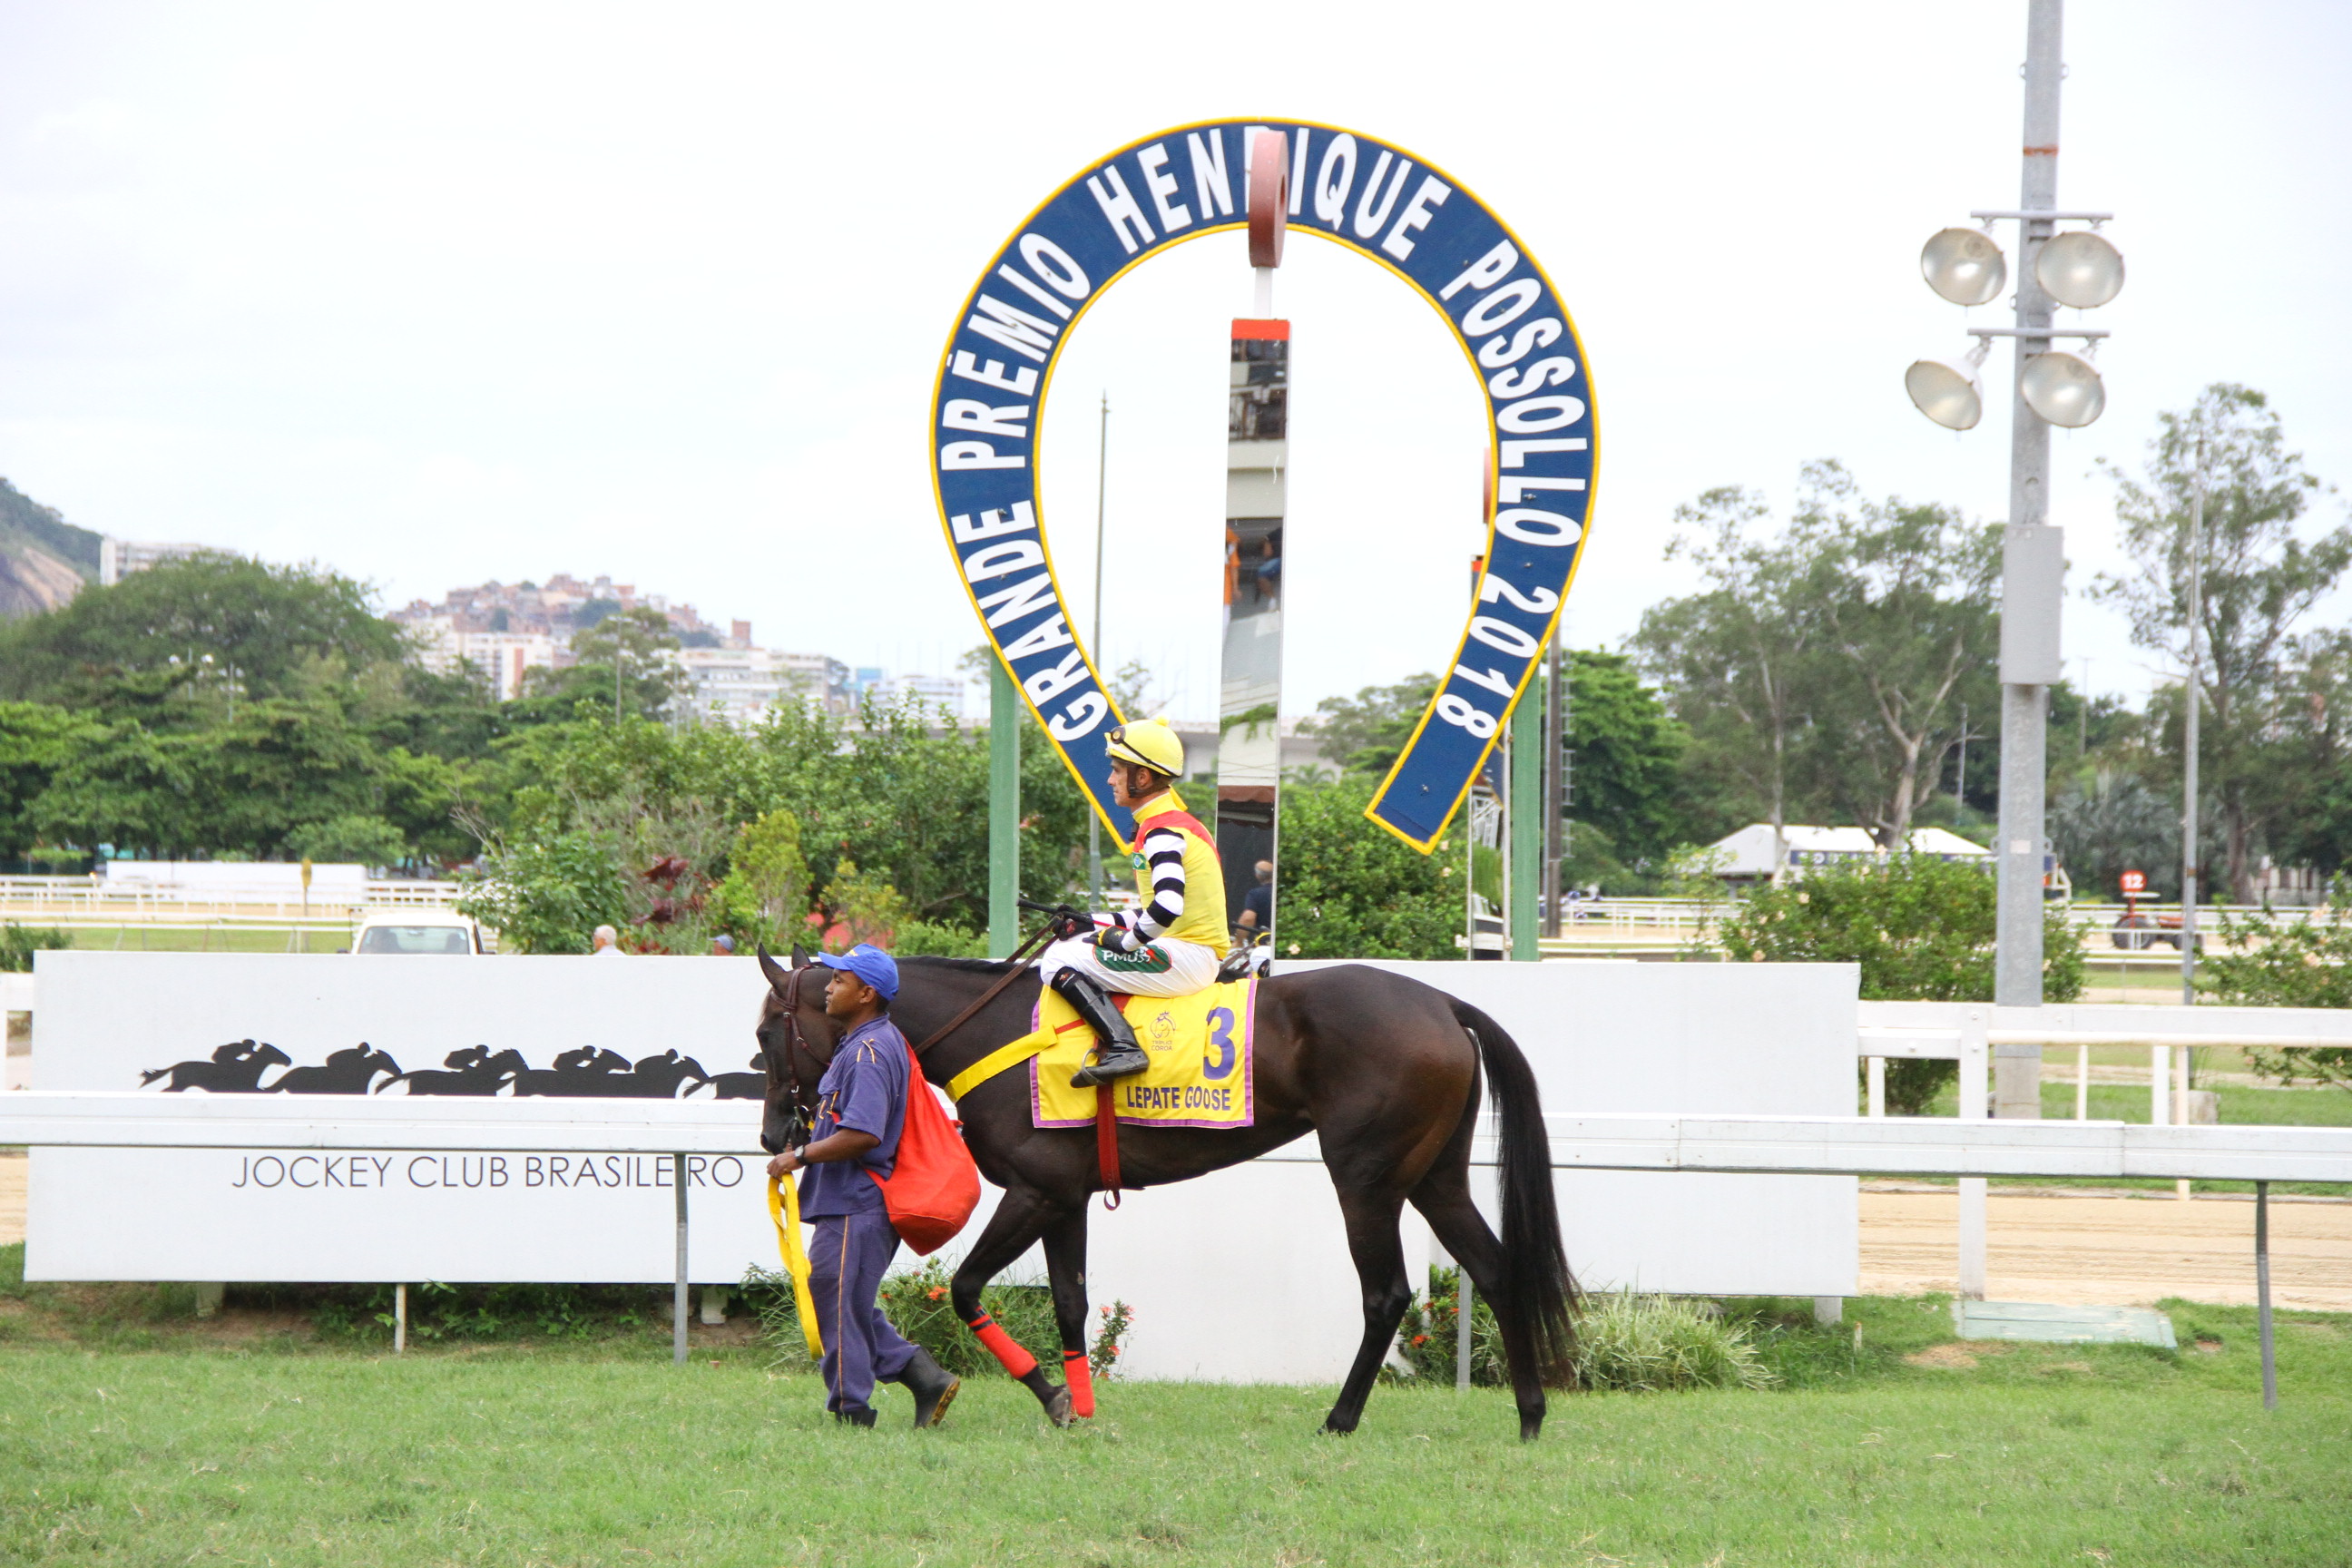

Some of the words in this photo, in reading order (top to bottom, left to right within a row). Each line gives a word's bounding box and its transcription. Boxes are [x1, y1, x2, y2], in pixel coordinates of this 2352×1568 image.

[1439, 240, 1587, 546] POSSOLLO
[951, 500, 1108, 741] GRANDE
[1436, 573, 1559, 739] 2018
[2122, 874, 2143, 889] 12
[1203, 1006, 1236, 1080] 3
[1126, 1085, 1180, 1109] LEPATE
[1184, 1085, 1231, 1112] GOOSE
[232, 1156, 392, 1188] JOCKEY
[407, 1156, 509, 1188] CLUB
[525, 1156, 743, 1187] BRASILERO
